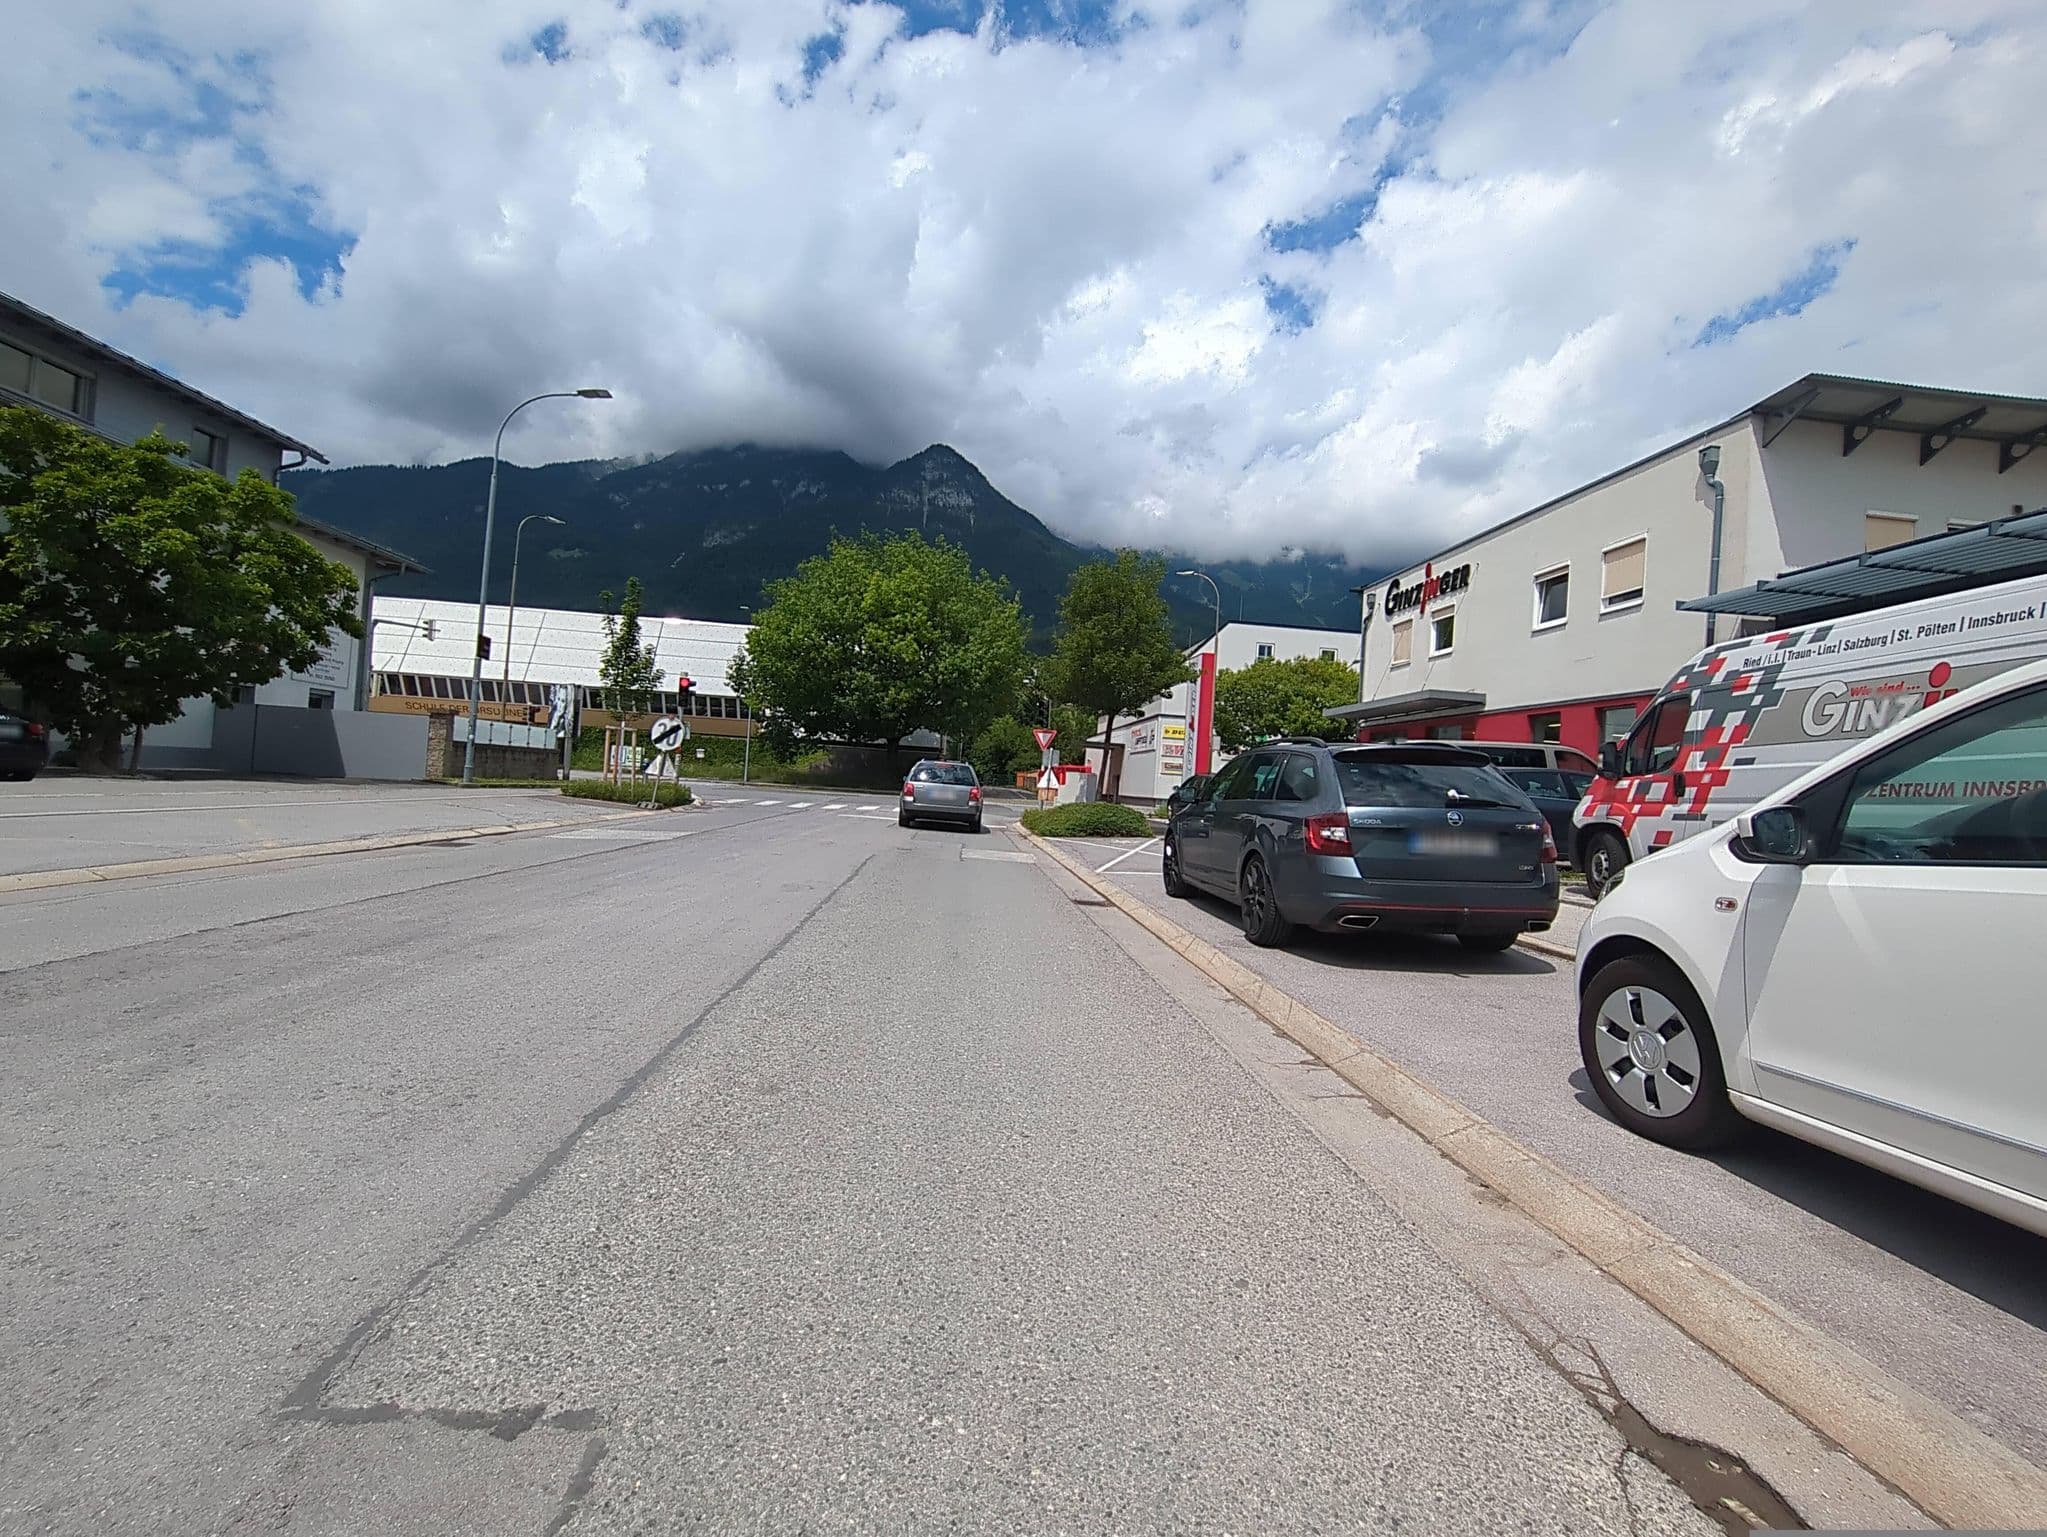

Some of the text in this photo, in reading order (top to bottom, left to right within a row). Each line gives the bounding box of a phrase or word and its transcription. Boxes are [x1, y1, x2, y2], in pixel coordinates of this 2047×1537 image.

[1743, 655, 1762, 669] Ried
[1843, 635, 1888, 651] Salzburg
[1897, 629, 1913, 642] St.
[1917, 621, 1957, 639] Pölten
[1967, 606, 2037, 630] Innsbruck
